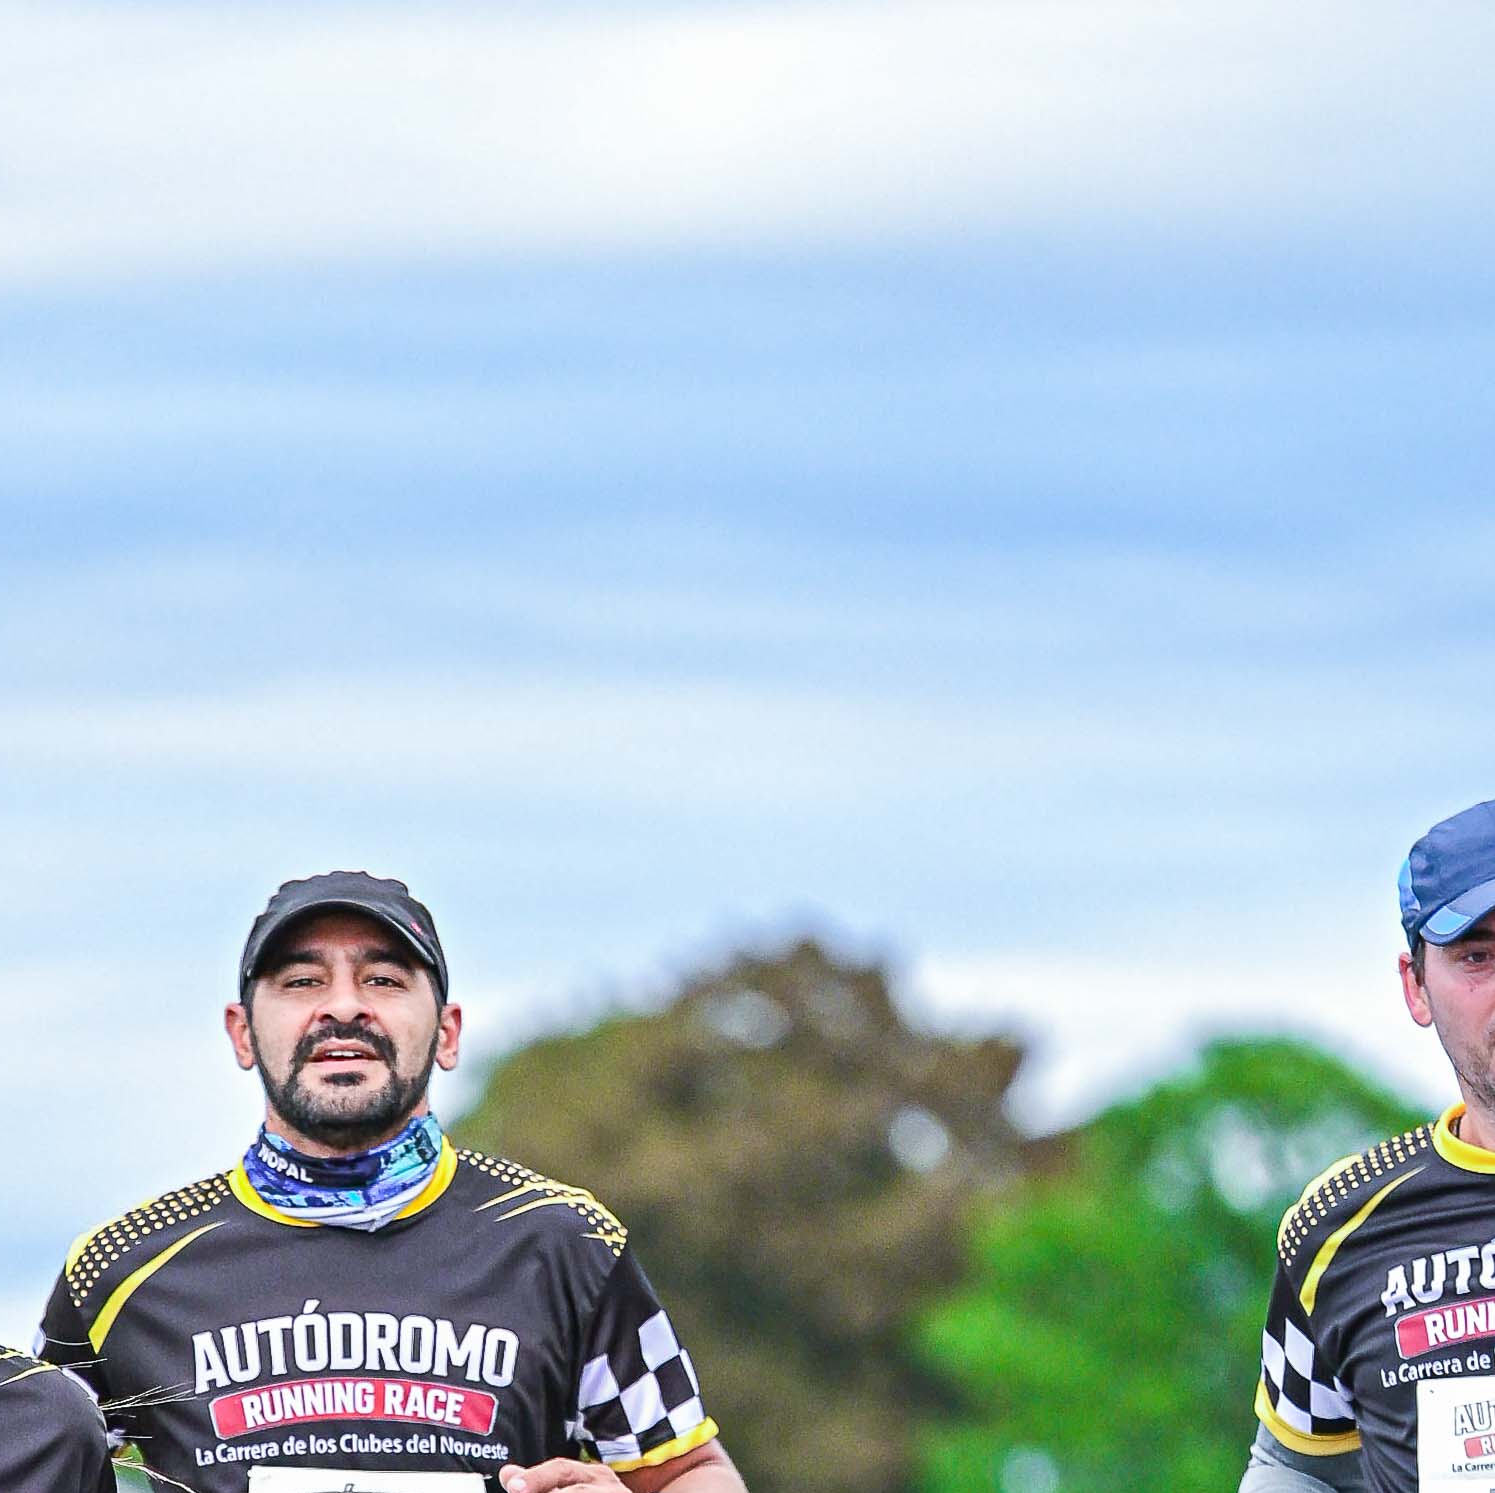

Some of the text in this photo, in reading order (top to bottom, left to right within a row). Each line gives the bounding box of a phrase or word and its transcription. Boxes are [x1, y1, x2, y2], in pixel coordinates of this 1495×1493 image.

[192, 1299, 520, 1394] AUTÓDROMO
[1380, 1350, 1491, 1388] La Carrera de
[241, 1382, 465, 1429] RUNNING RACE
[195, 1433, 509, 1466] La Carrera de los Clubes del Noroeste
[1452, 1463, 1463, 1473] La
